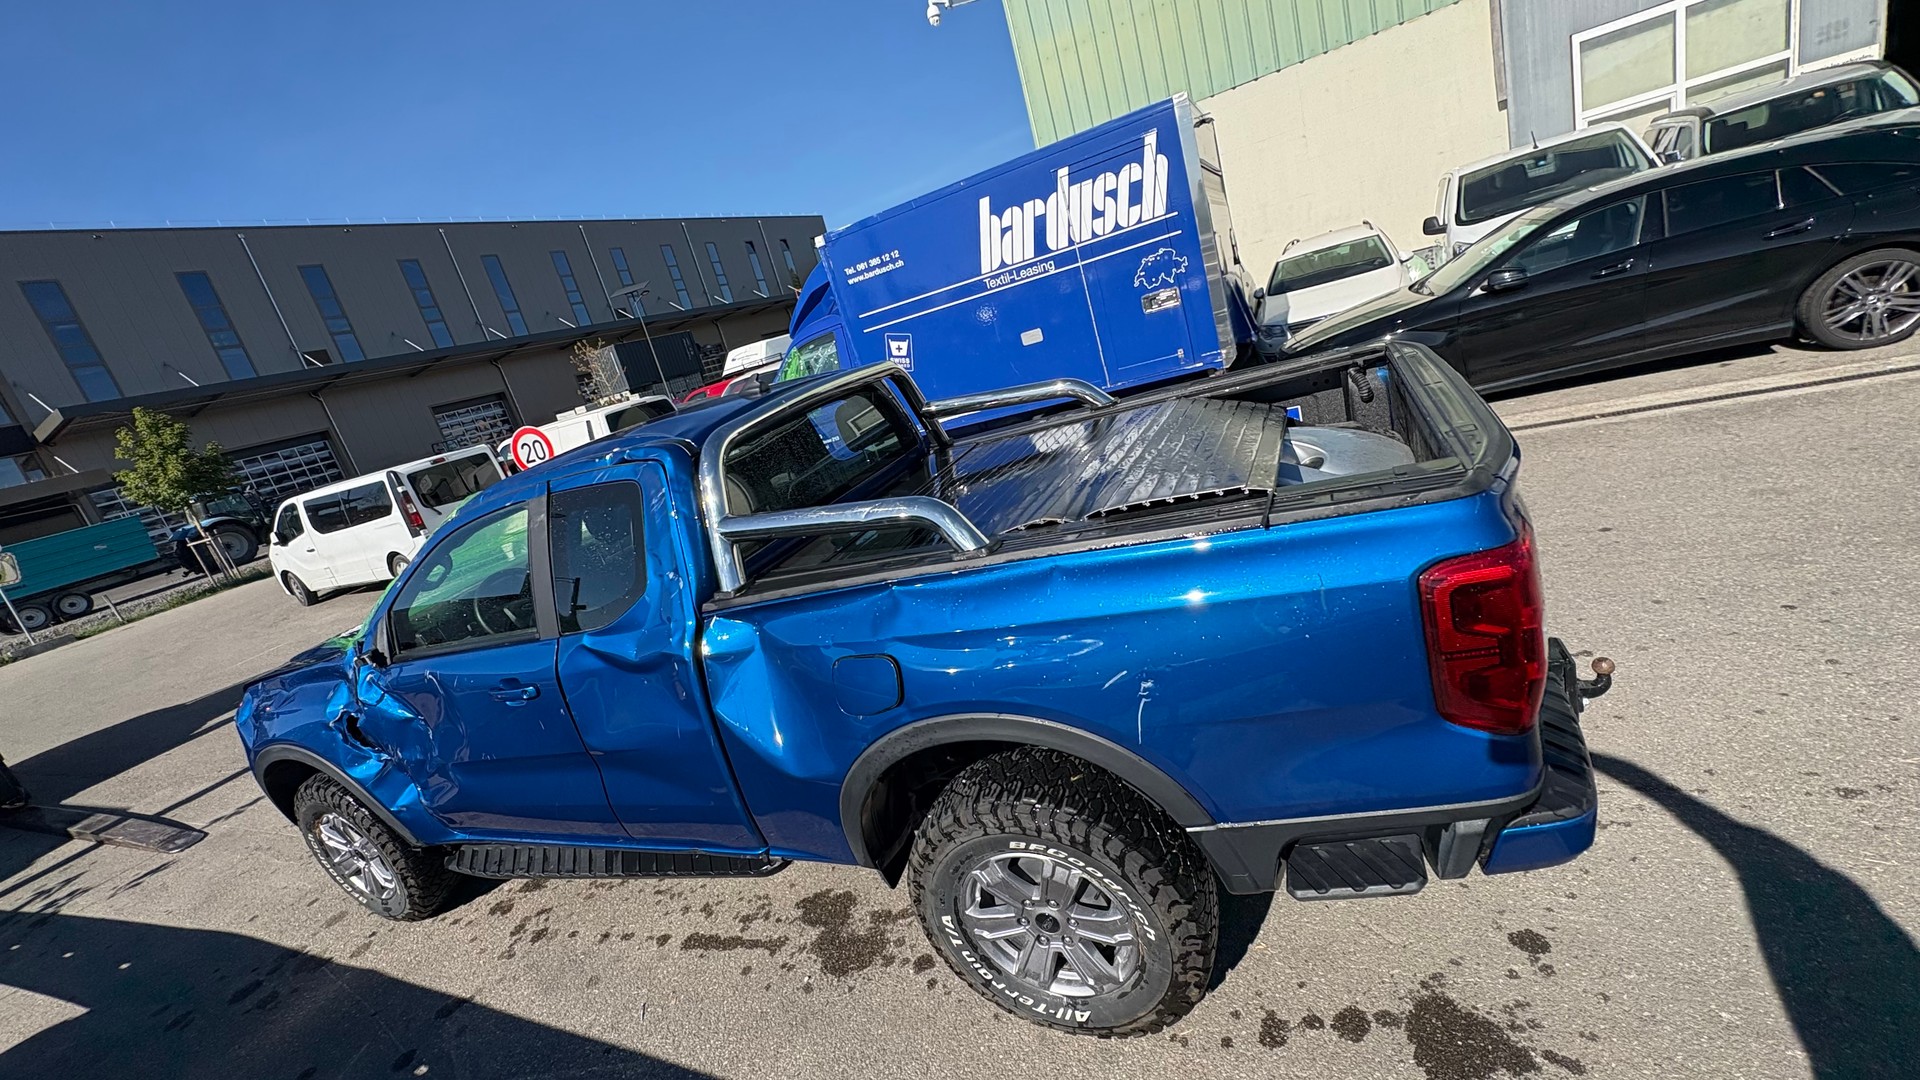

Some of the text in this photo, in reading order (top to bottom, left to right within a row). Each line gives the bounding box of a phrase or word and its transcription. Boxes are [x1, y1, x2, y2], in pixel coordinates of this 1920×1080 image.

[979, 128, 1169, 274] bardusch
[844, 266, 856, 275] Tel.
[881, 253, 890, 262] 12
[890, 249, 900, 258] 12
[847, 260, 904, 285] www.bardusch.ch
[983, 260, 1055, 289] Textil-Leasing
[521, 440, 546, 464] 20
[1009, 841, 1155, 941] BFGoodrich
[941, 915, 1091, 1022] All-Terrain T/A
